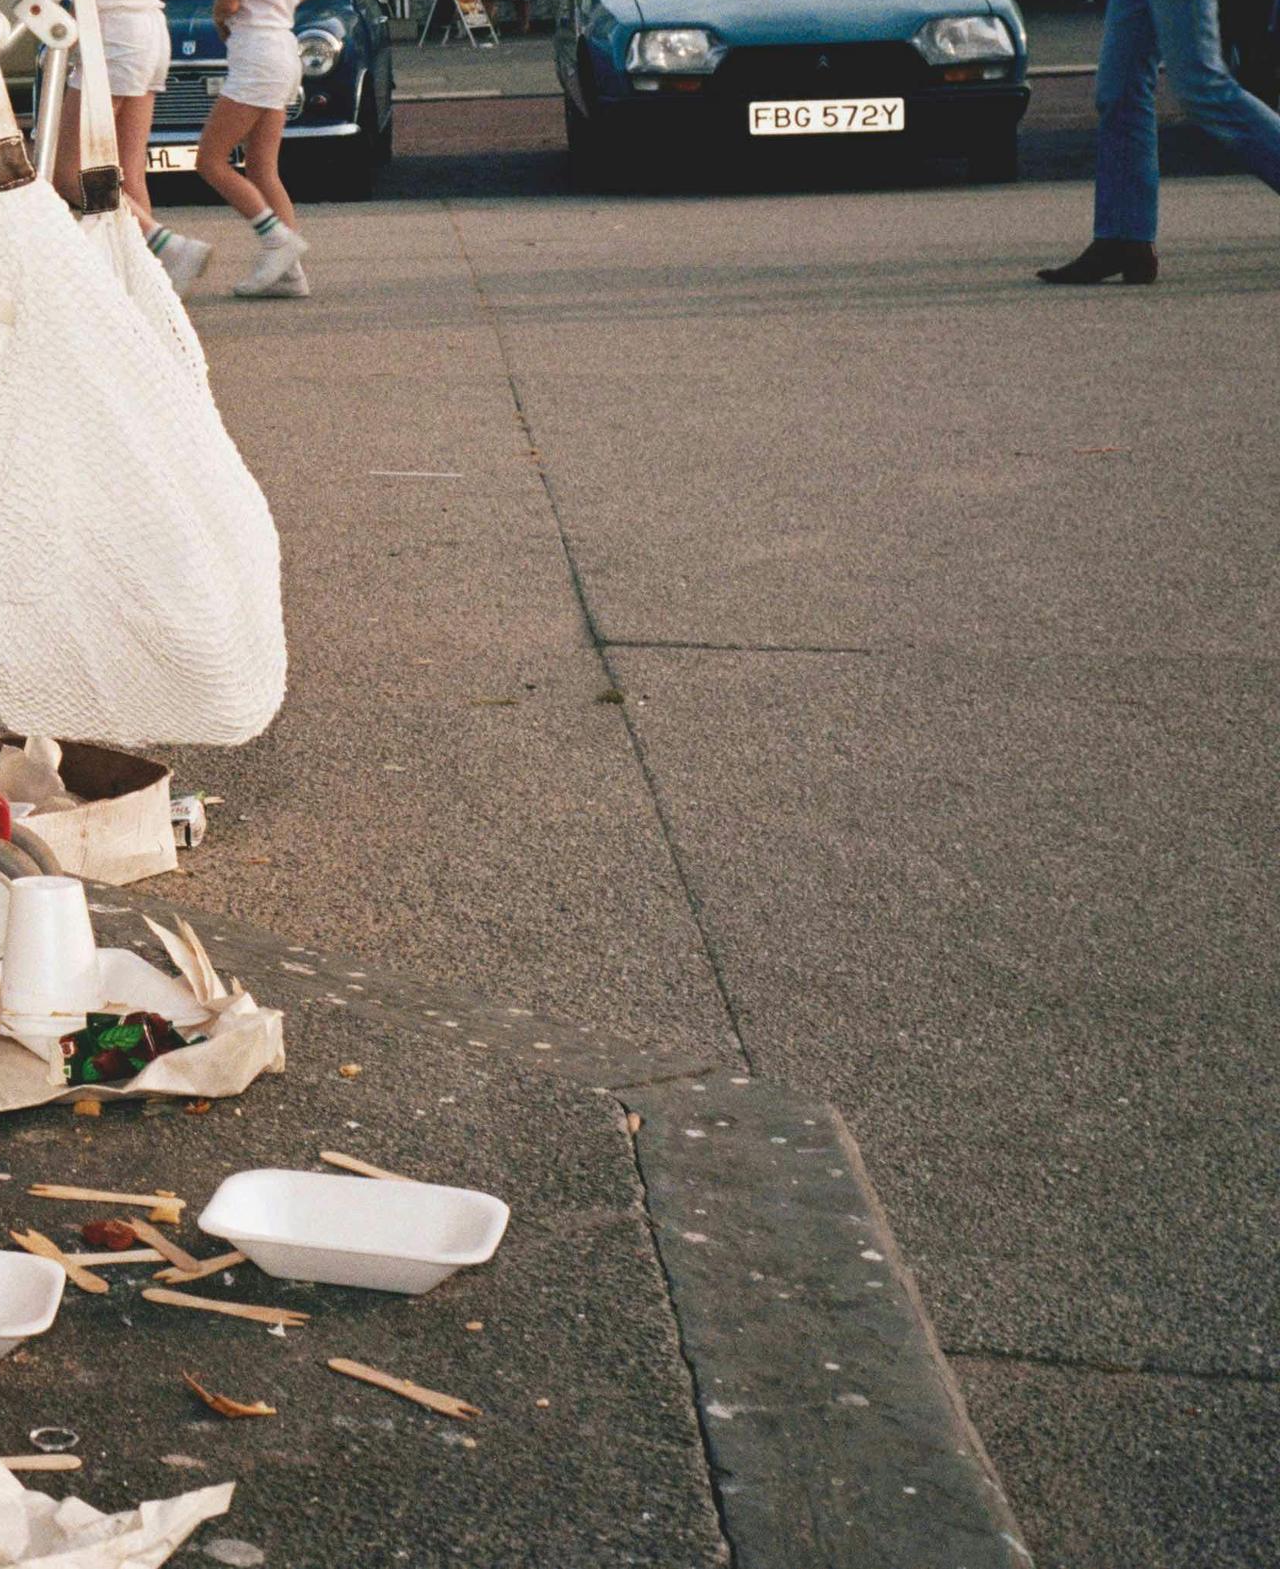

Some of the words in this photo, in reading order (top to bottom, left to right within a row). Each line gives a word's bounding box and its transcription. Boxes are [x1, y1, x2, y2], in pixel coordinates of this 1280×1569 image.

[754, 107, 811, 129] FBG
[823, 104, 898, 128] 572Y
[147, 148, 181, 168] HL
